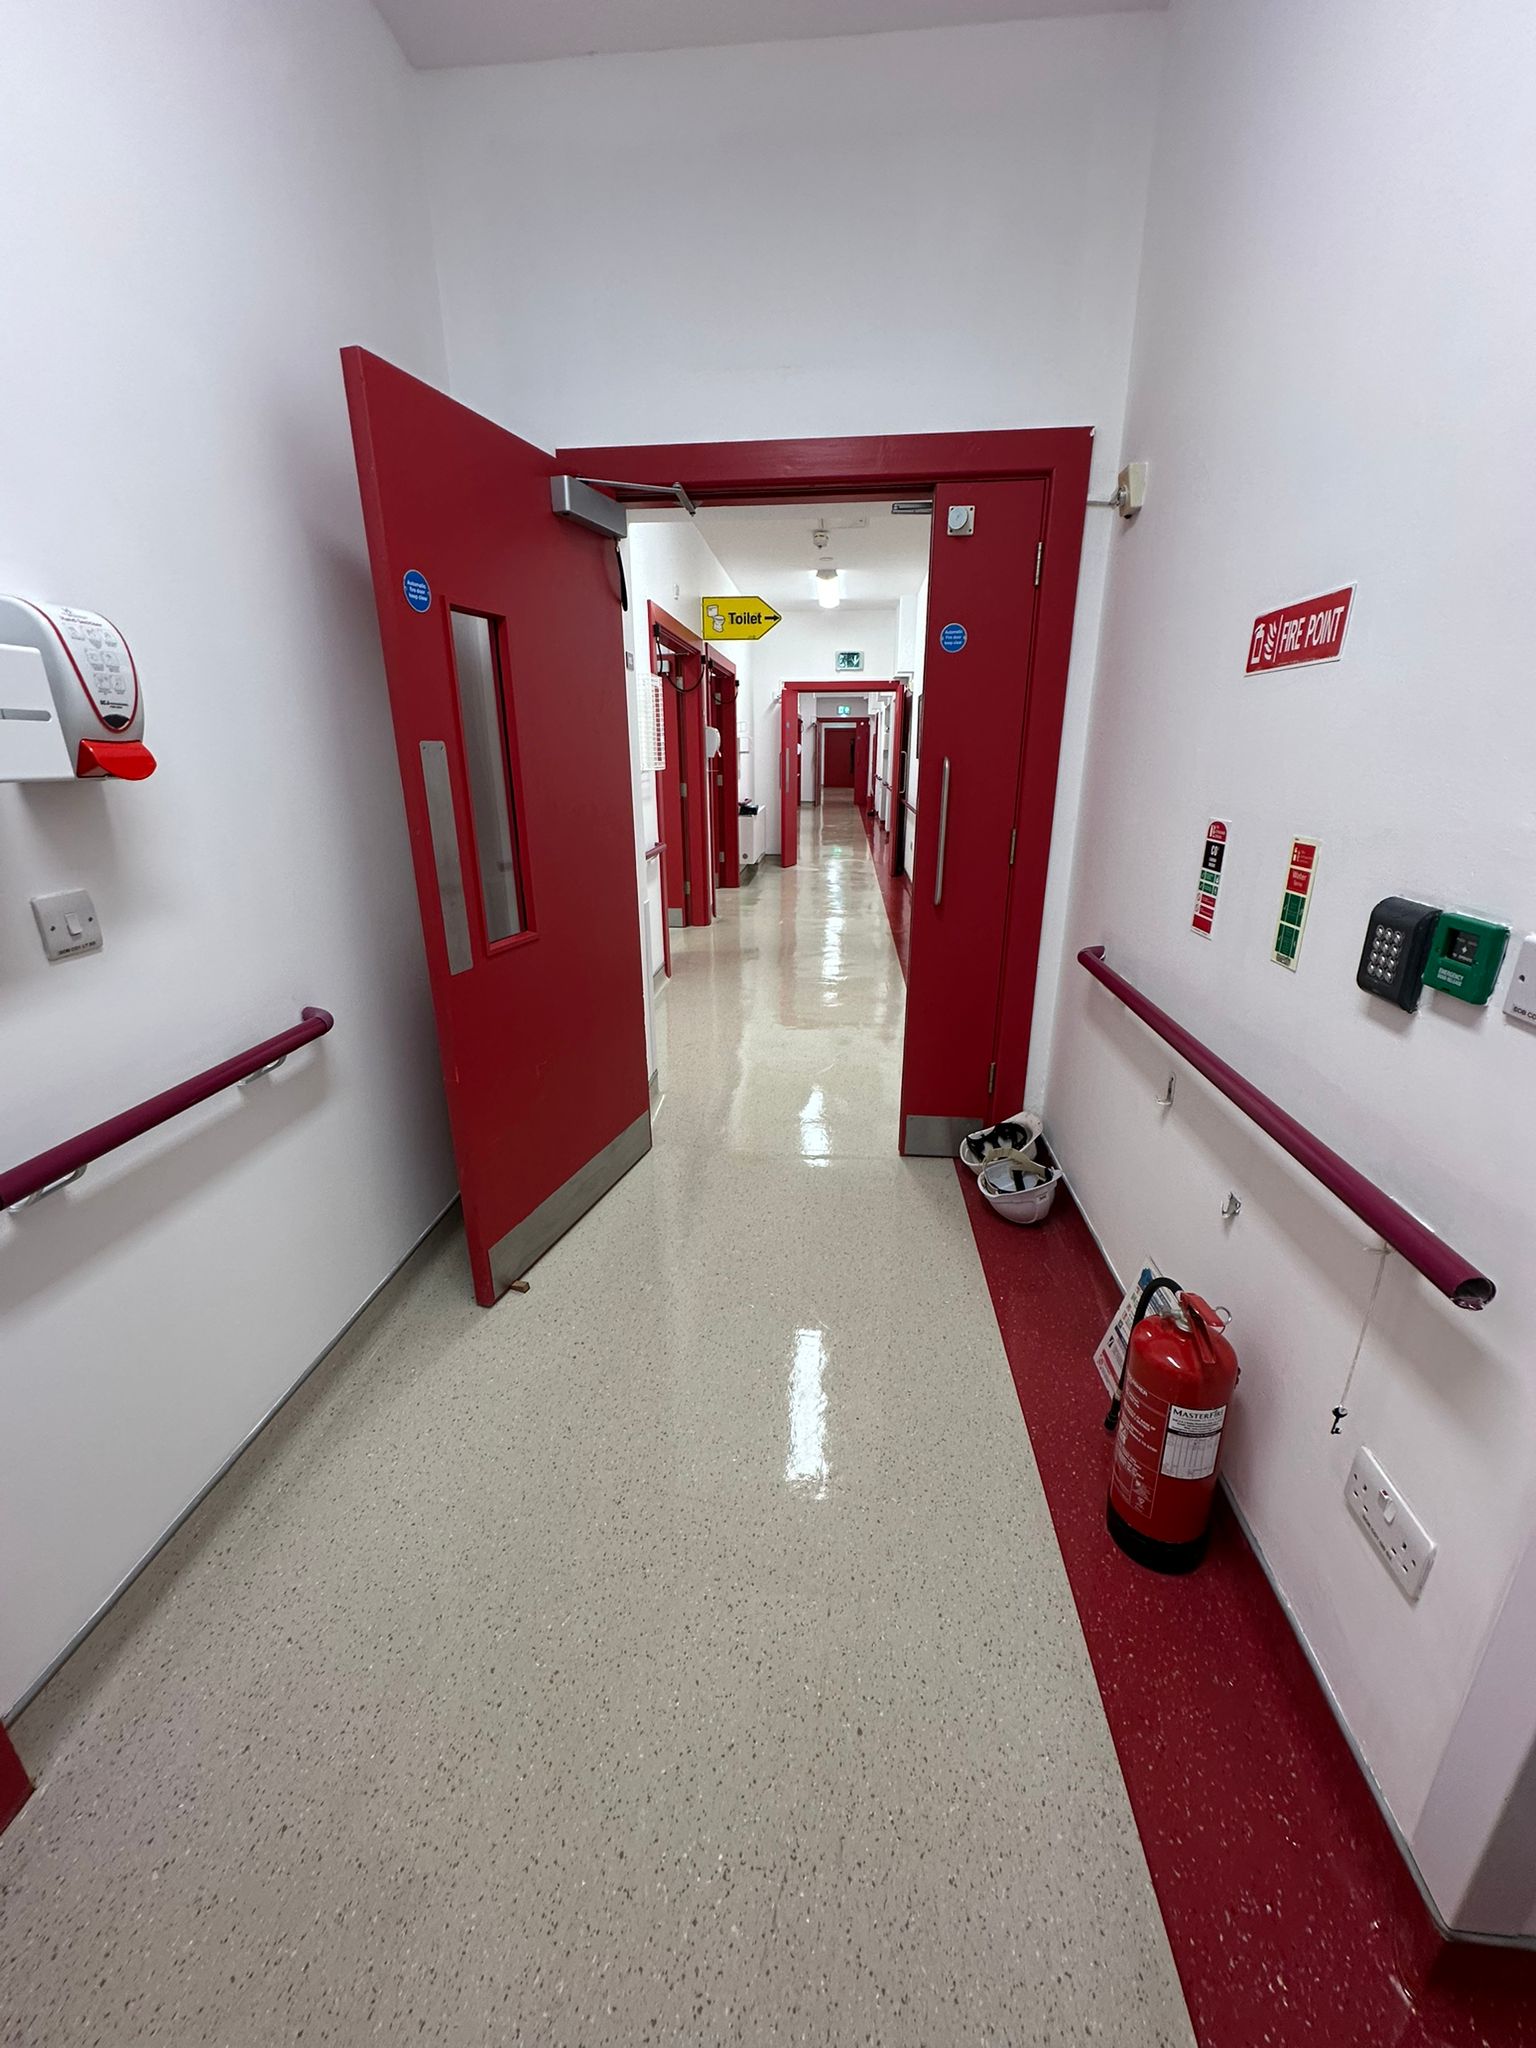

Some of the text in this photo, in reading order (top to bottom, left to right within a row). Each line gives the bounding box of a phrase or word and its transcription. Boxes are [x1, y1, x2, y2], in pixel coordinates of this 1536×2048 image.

[728, 612, 762, 625] Toilet
[1279, 606, 1345, 653] FIRE POINT
[1439, 967, 1464, 980] EMERGENCY
